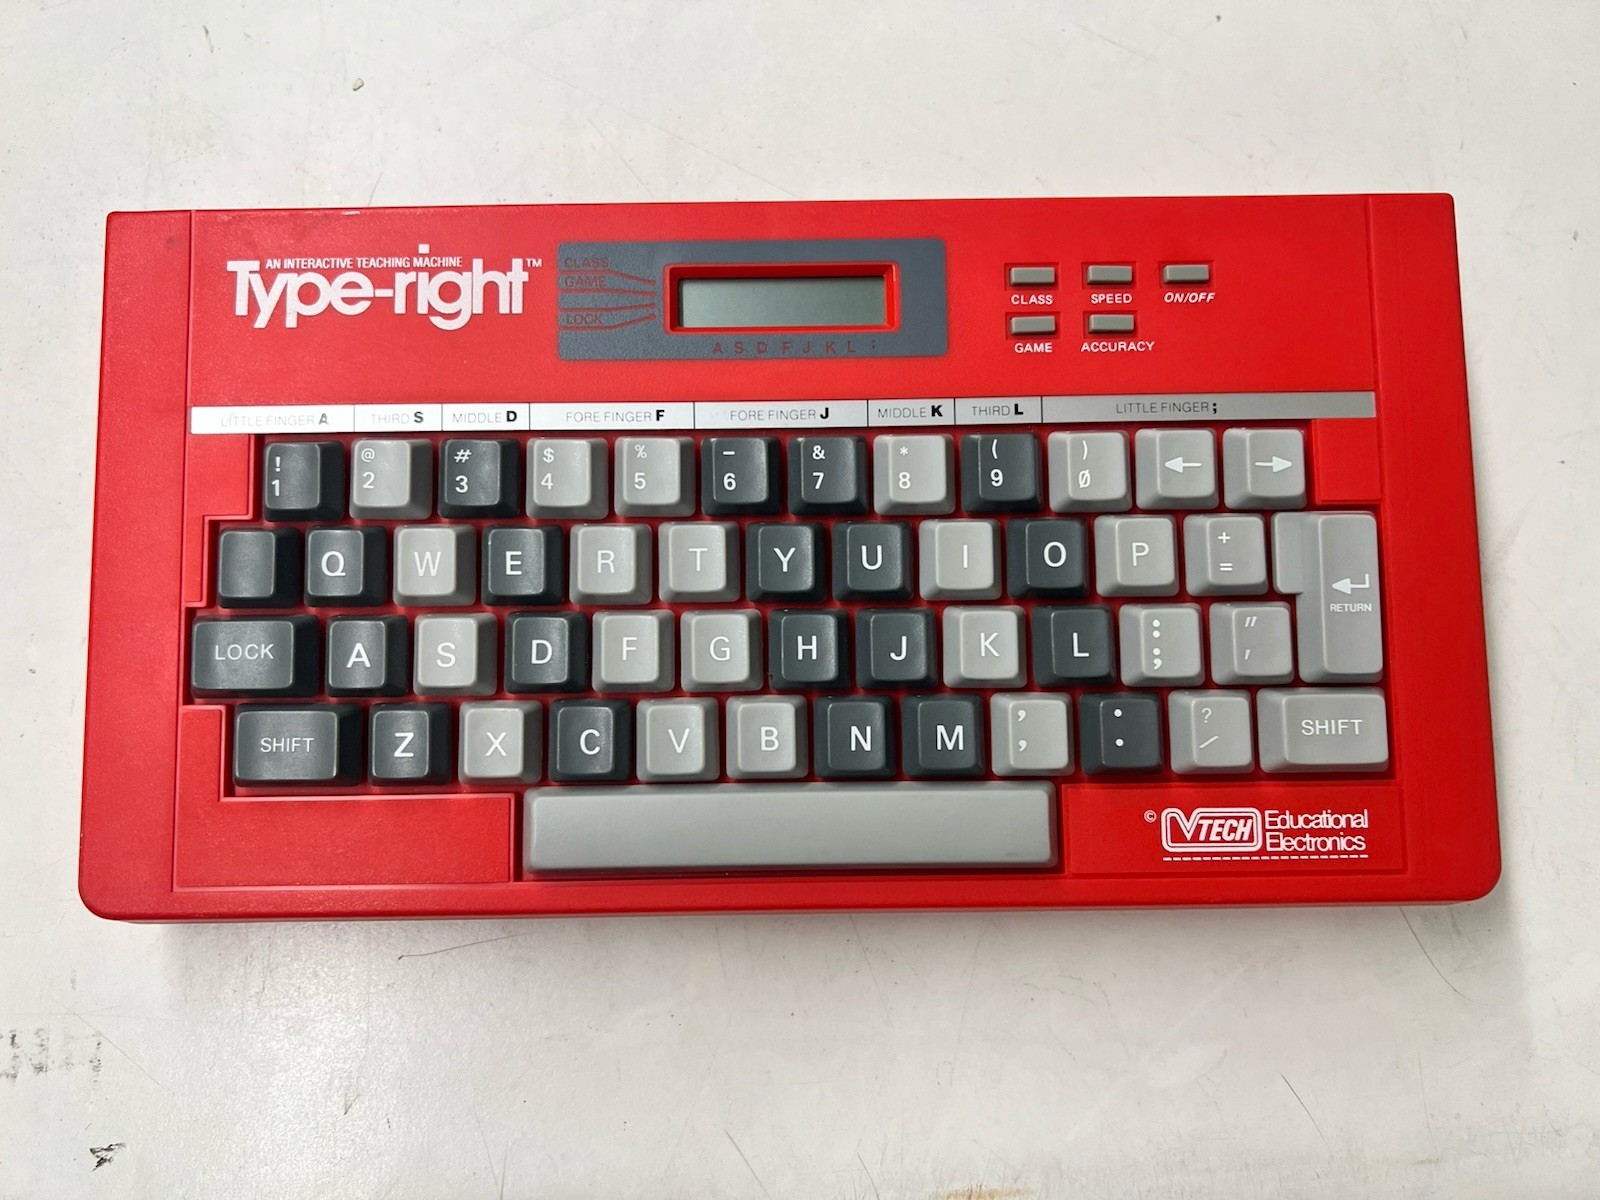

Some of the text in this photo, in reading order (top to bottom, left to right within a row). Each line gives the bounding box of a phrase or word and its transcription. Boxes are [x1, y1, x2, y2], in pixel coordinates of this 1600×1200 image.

[265, 256, 462, 269] AN INTERACTIVE TEACHING MACHINE
[564, 257, 610, 268] CLASS
[226, 243, 529, 331] Type-right
[564, 276, 606, 287] GAME
[1010, 294, 1053, 305] CLASS
[1090, 293, 1133, 304] SPEED
[1163, 292, 1216, 304] ON/OFF
[566, 313, 602, 324] LOCK
[1014, 342, 1053, 354] GAME
[1080, 341, 1155, 353] ACCURACY
[730, 407, 830, 421] FORE FINGER J
[877, 405, 943, 419] MIDDLE K
[971, 403, 1024, 416] THIRD L
[1115, 402, 1158, 414] LITTLE
[1160, 401, 1210, 413] FINGER
[221, 413, 329, 428] LITTLE FINGER A
[371, 411, 424, 425] THIRD S
[452, 410, 517, 424] MIDDLE D
[566, 409, 666, 423] FORE FINGER F
[361, 448, 375, 462] @
[454, 449, 471, 462] #
[543, 448, 554, 463] $
[635, 445, 647, 458] %
[813, 445, 825, 459] &
[363, 472, 374, 488] 2
[456, 476, 468, 492] 3
[541, 473, 553, 489] 4
[635, 473, 646, 489] 5
[724, 473, 736, 490] 6
[813, 472, 824, 489] 7
[899, 472, 910, 488] 8
[991, 469, 1003, 486] 9
[272, 480, 279, 496] 1
[506, 551, 522, 574] E
[598, 550, 614, 573] R
[689, 548, 708, 571] T
[774, 548, 795, 572] Y
[862, 545, 882, 569] U
[964, 545, 967, 568] I
[1044, 542, 1066, 567] O
[1133, 543, 1149, 566] P
[322, 551, 346, 576] Q
[414, 552, 441, 576] W
[1331, 604, 1371, 612] RETURN
[216, 644, 273, 660] LOCK
[531, 639, 552, 665] D
[623, 637, 637, 660] F
[710, 637, 730, 660] G
[798, 636, 816, 660] H
[890, 636, 906, 660] J
[981, 633, 999, 656] K
[1073, 633, 1089, 656] L
[347, 643, 370, 667] A
[437, 642, 455, 667] S
[1202, 708, 1211, 723] ?
[1302, 720, 1362, 735] SHIFT
[261, 738, 314, 752] SHIFT
[394, 732, 414, 757] Z
[486, 732, 506, 756] X
[580, 729, 603, 754] C
[668, 728, 690, 754] V
[761, 727, 778, 750] B
[851, 726, 871, 751] N
[937, 725, 963, 750] M
[1163, 808, 1255, 845] VTECH
[1264, 809, 1369, 829] Educational
[1265, 832, 1366, 852] Electronics
